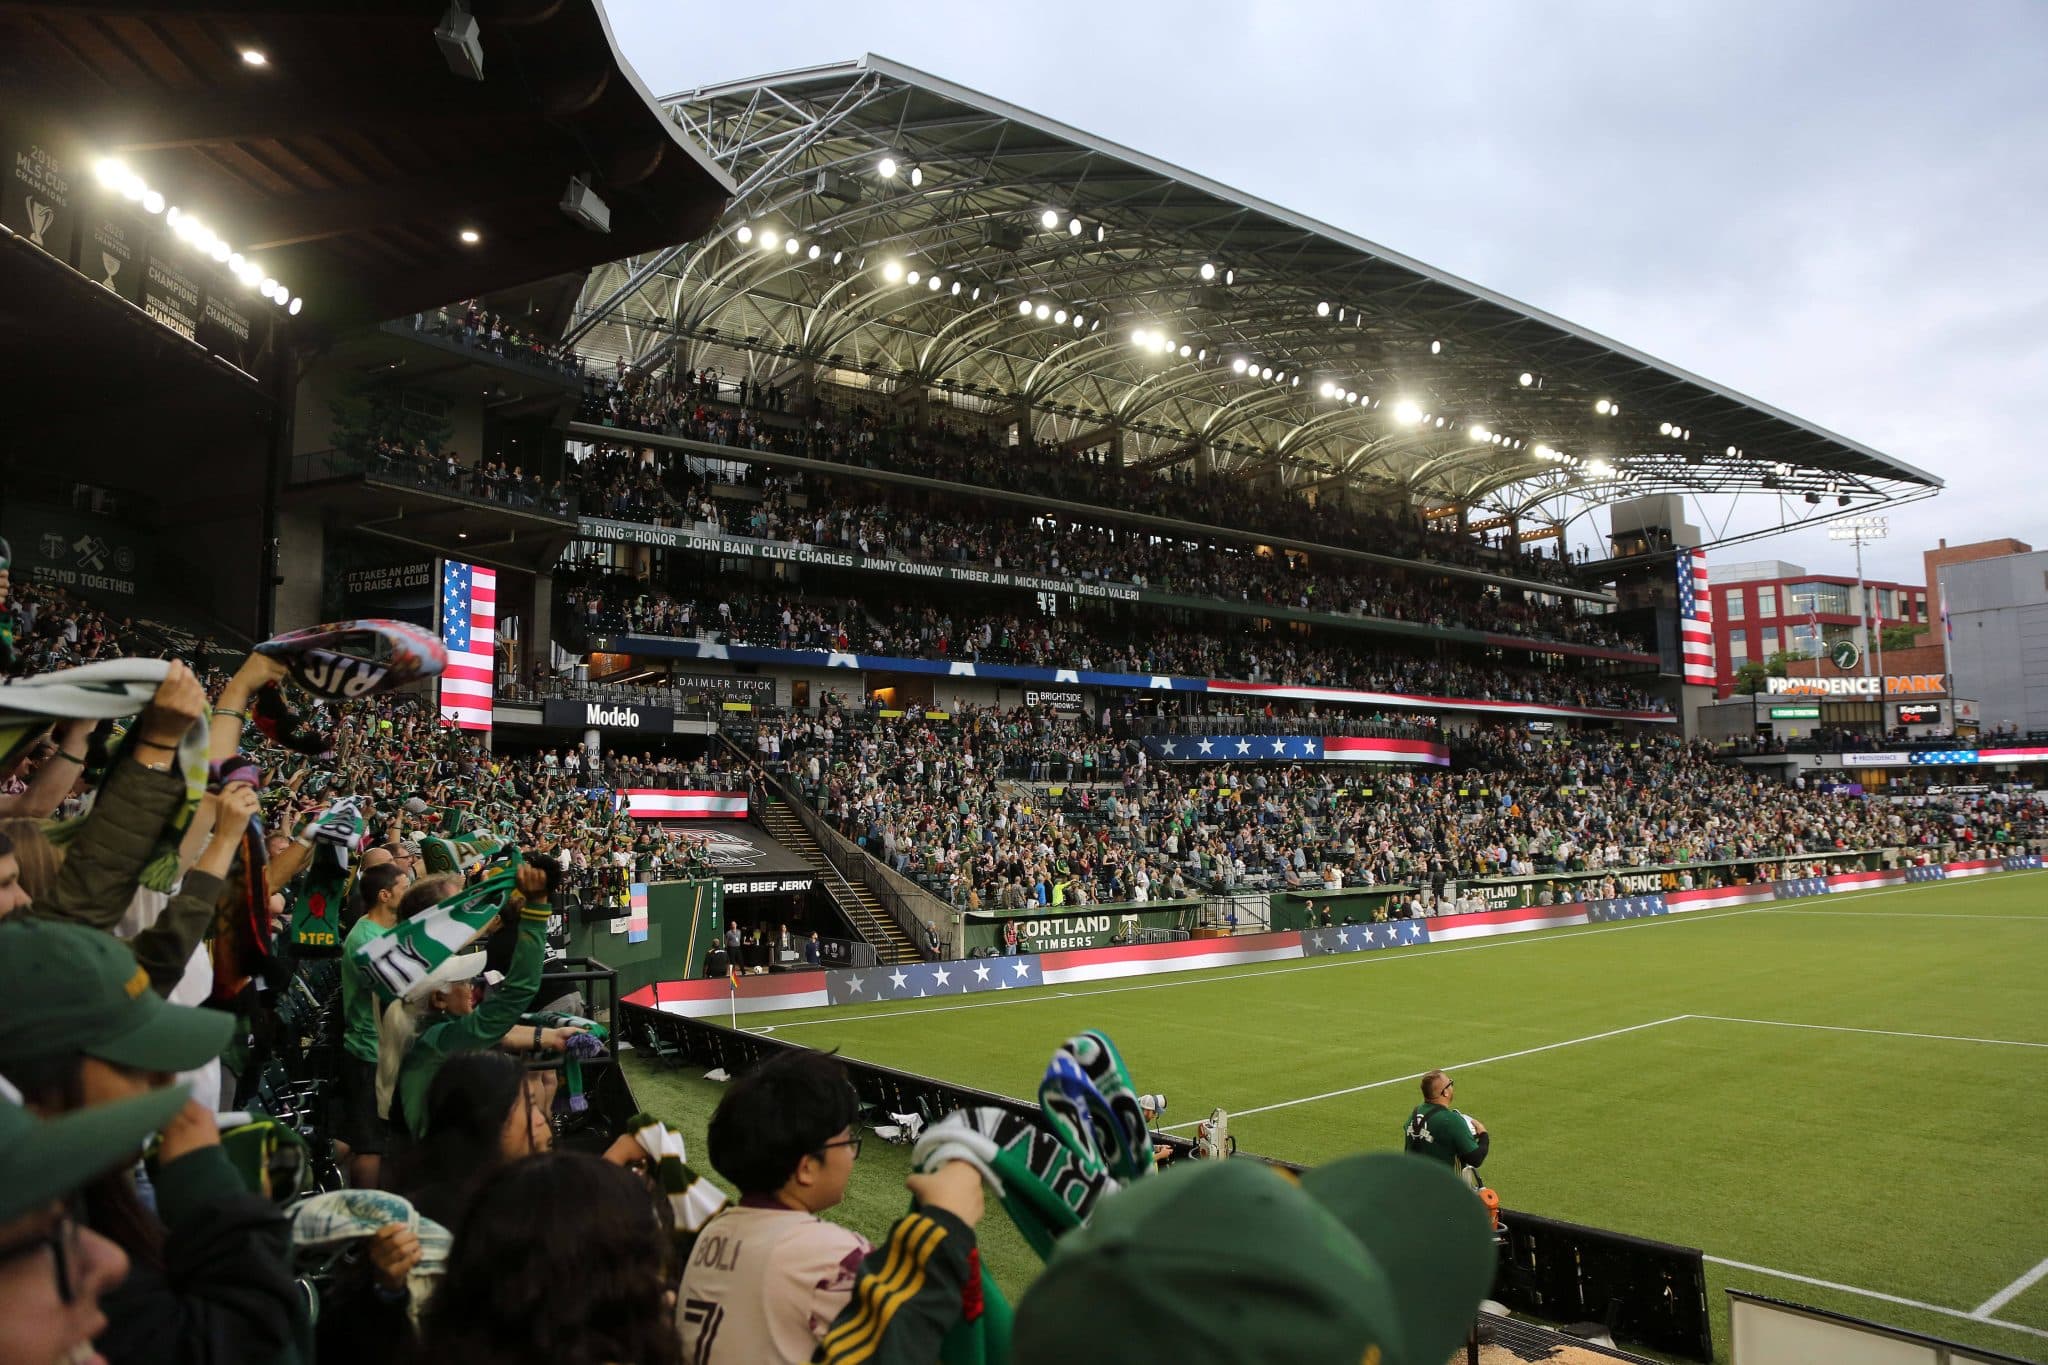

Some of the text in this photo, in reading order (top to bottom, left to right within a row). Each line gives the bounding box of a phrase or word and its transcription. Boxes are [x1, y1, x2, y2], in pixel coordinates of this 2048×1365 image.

[45, 171, 68, 194] CUP
[148, 266, 198, 306] CHAMPIONS
[145, 304, 196, 341] CHAMPIONS
[205, 304, 249, 340] CHAMPIONS
[348, 562, 430, 582] IT TAKES AN ARMY
[595, 525, 625, 540] RING
[635, 530, 677, 546] HONOR
[686, 537, 720, 552] JOHN
[724, 541, 754, 556] BAIN
[762, 546, 796, 560] CLIVE
[799, 550, 853, 567] CHARLES
[861, 557, 897, 572] JIMMY
[899, 562, 944, 577] CONWAY
[950, 568, 989, 583] TIMBER
[991, 573, 1009, 585] JIM
[1014, 576, 1039, 589] MICK
[1040, 579, 1073, 593] HOBAN
[1079, 584, 1106, 597] DIEGO
[1108, 587, 1140, 601] VALERI
[33, 566, 136, 596] STAND TOGETHER
[348, 574, 430, 593] TO RAISE A CLUB
[1767, 674, 1946, 696] PROVIDENCE PARK
[1040, 691, 1083, 703] BRIGHTSIDE
[586, 703, 640, 728] Modelo
[750, 881, 778, 893] BEEF
[779, 880, 812, 891] JERKY
[299, 931, 335, 946] PTFC
[1036, 936, 1092, 950] TIMBERS
[684, 1298, 725, 1365] 7
